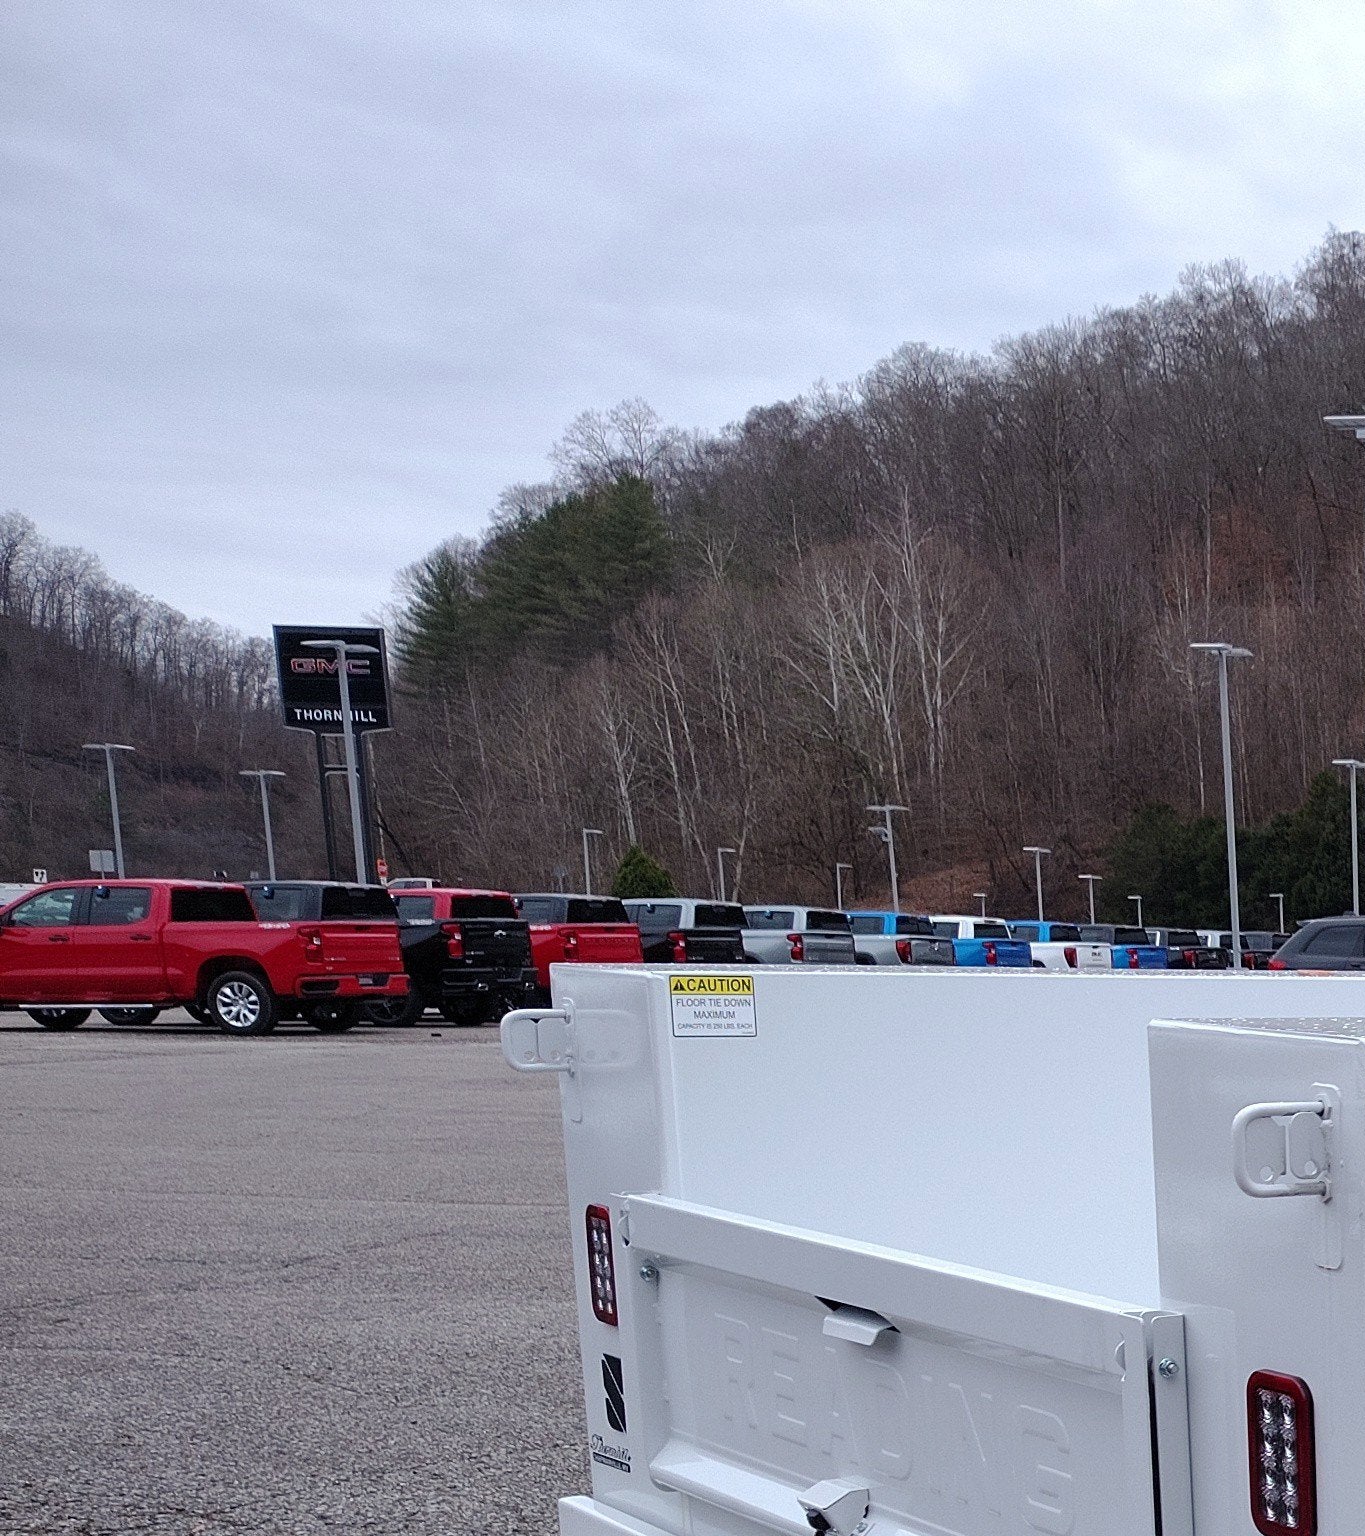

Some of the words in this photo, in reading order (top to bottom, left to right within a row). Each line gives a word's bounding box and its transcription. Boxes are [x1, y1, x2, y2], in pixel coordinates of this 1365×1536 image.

[290, 658, 371, 675] GMC
[686, 978, 751, 992] CAUTION
[676, 998, 707, 1008] FLOOR
[709, 998, 722, 1008] TIE
[723, 998, 752, 1008] DOWN
[693, 1010, 736, 1020] MAXIMUM
